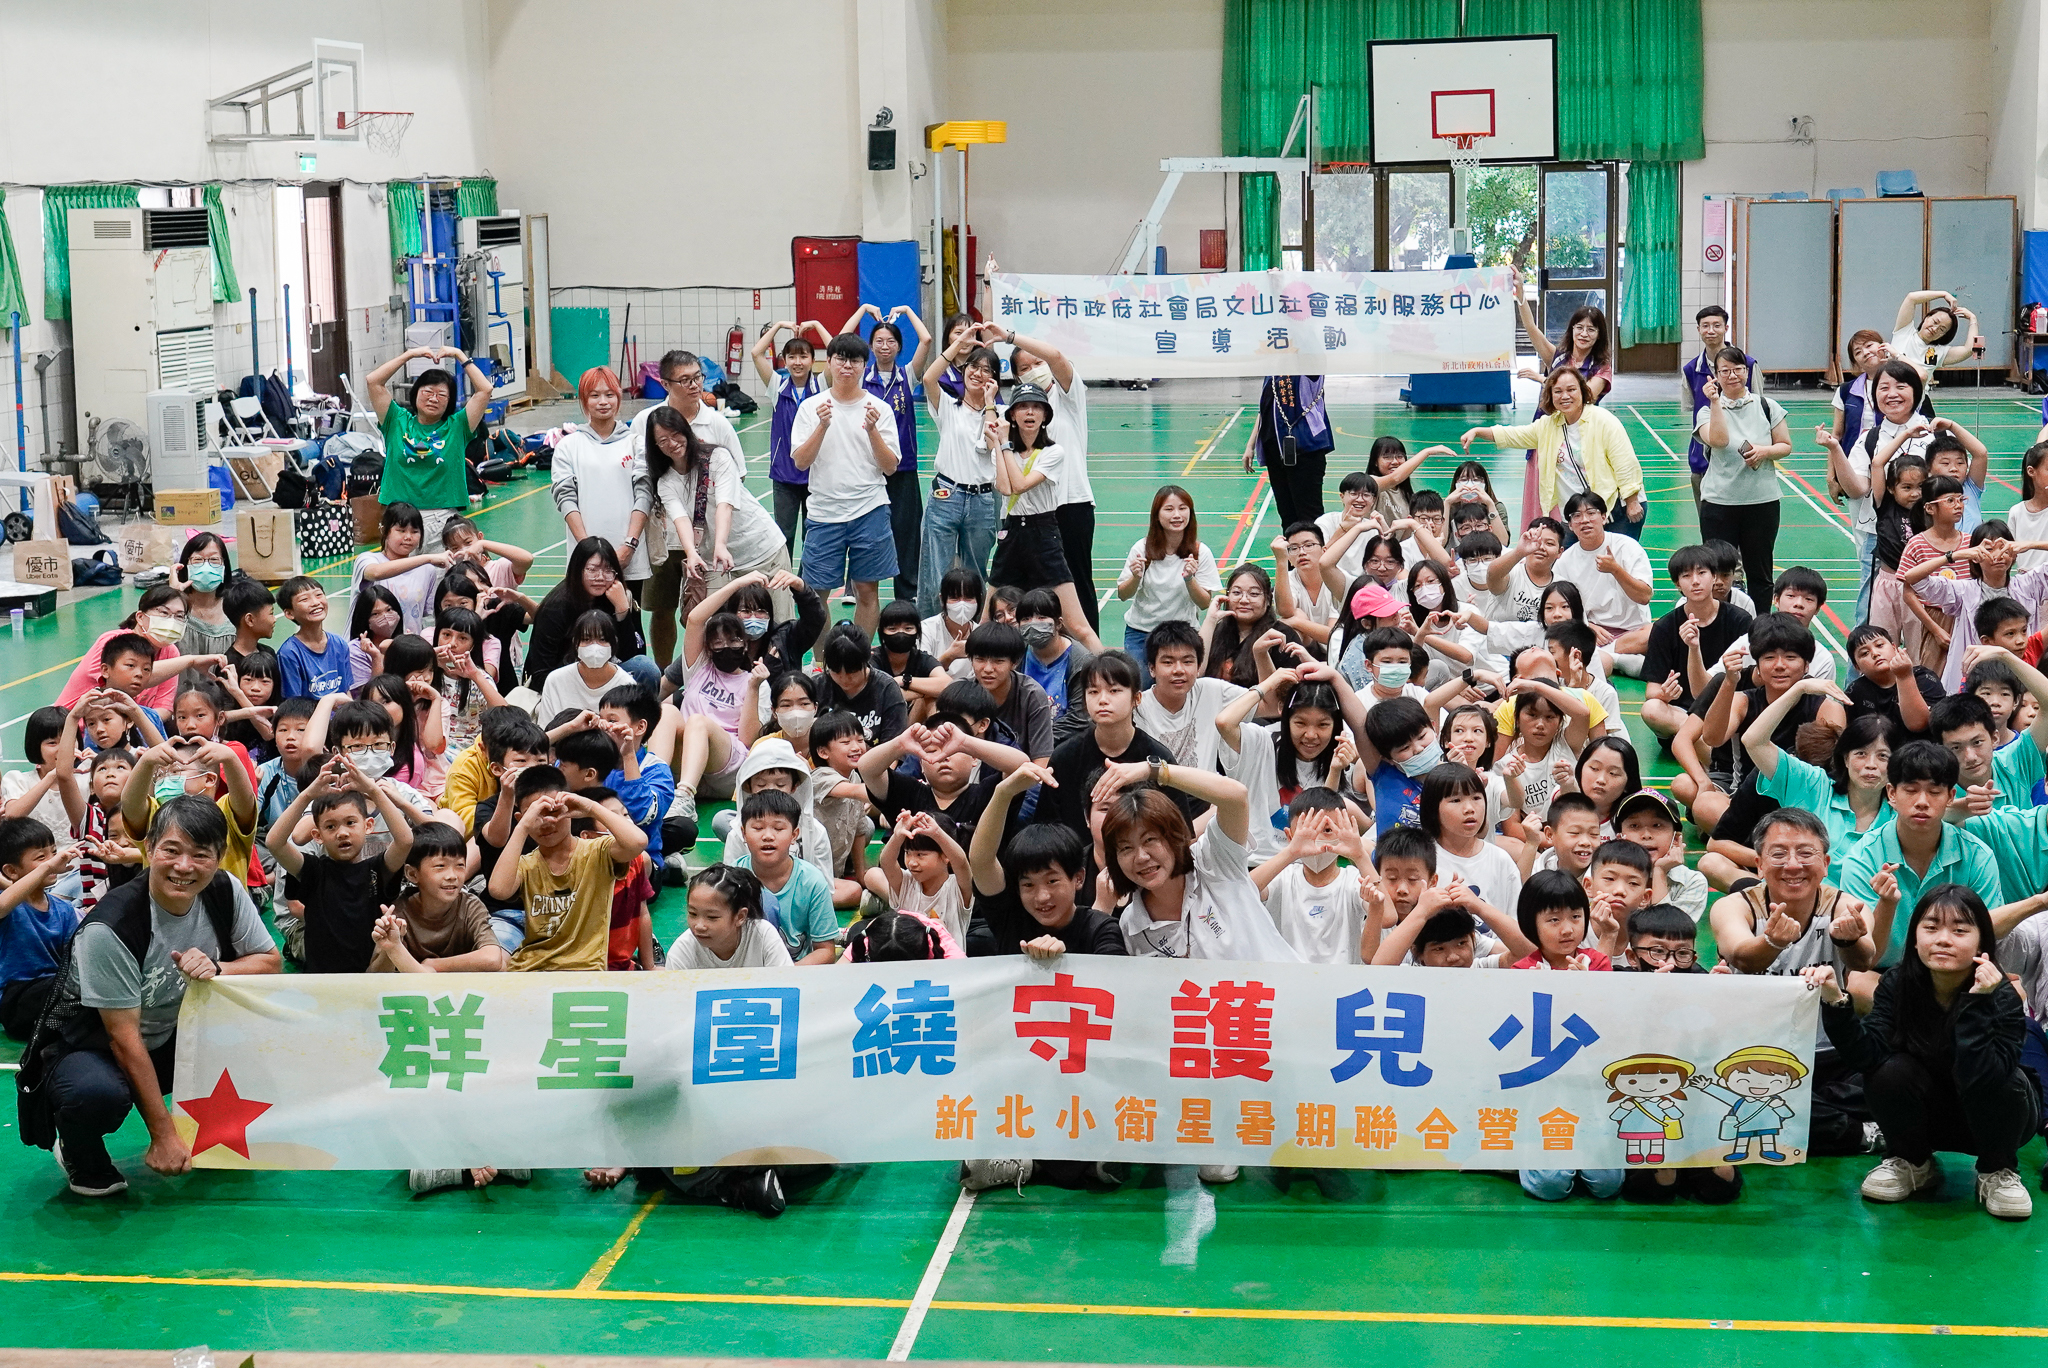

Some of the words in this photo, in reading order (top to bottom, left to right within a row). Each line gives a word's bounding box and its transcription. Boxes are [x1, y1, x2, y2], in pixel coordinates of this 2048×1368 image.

[1001, 291, 1501, 321] 新北市政府社會局文山社會福利服務中心
[1155, 325, 1347, 354] 宣導活動
[240, 470, 260, 481] GU
[25, 556, 58, 573] 優市
[378, 972, 1601, 1092] 群星圍繞守護兒少
[934, 1094, 1581, 1152] 新北小衛星暑期聯合營會
